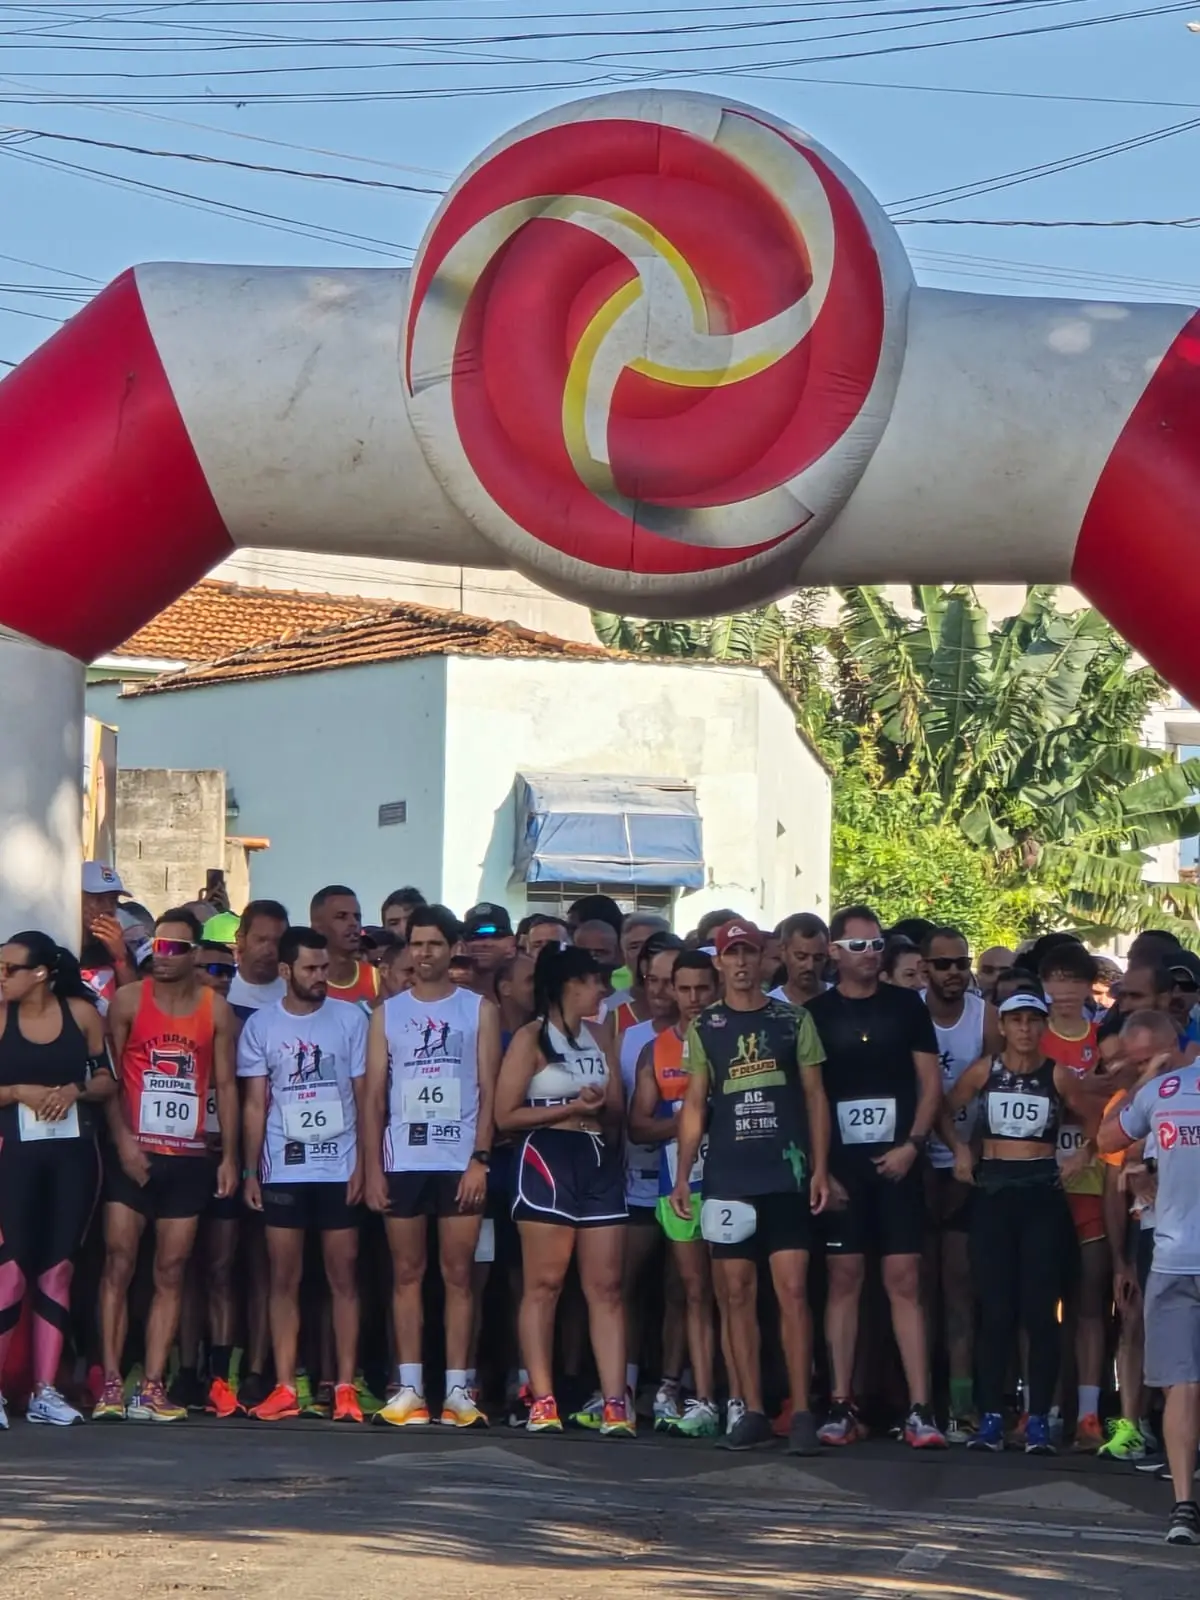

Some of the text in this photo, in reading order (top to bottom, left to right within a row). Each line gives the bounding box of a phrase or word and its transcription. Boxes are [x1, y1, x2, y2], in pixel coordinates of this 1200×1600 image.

[576, 1057, 605, 1076] 173
[418, 1086, 444, 1104] 46
[744, 1091, 763, 1103] AC
[153, 1101, 190, 1121] 180
[300, 1110, 326, 1128] 26
[849, 1107, 887, 1126] 287
[1000, 1101, 1040, 1121] 105
[721, 1209, 733, 1226] 2
